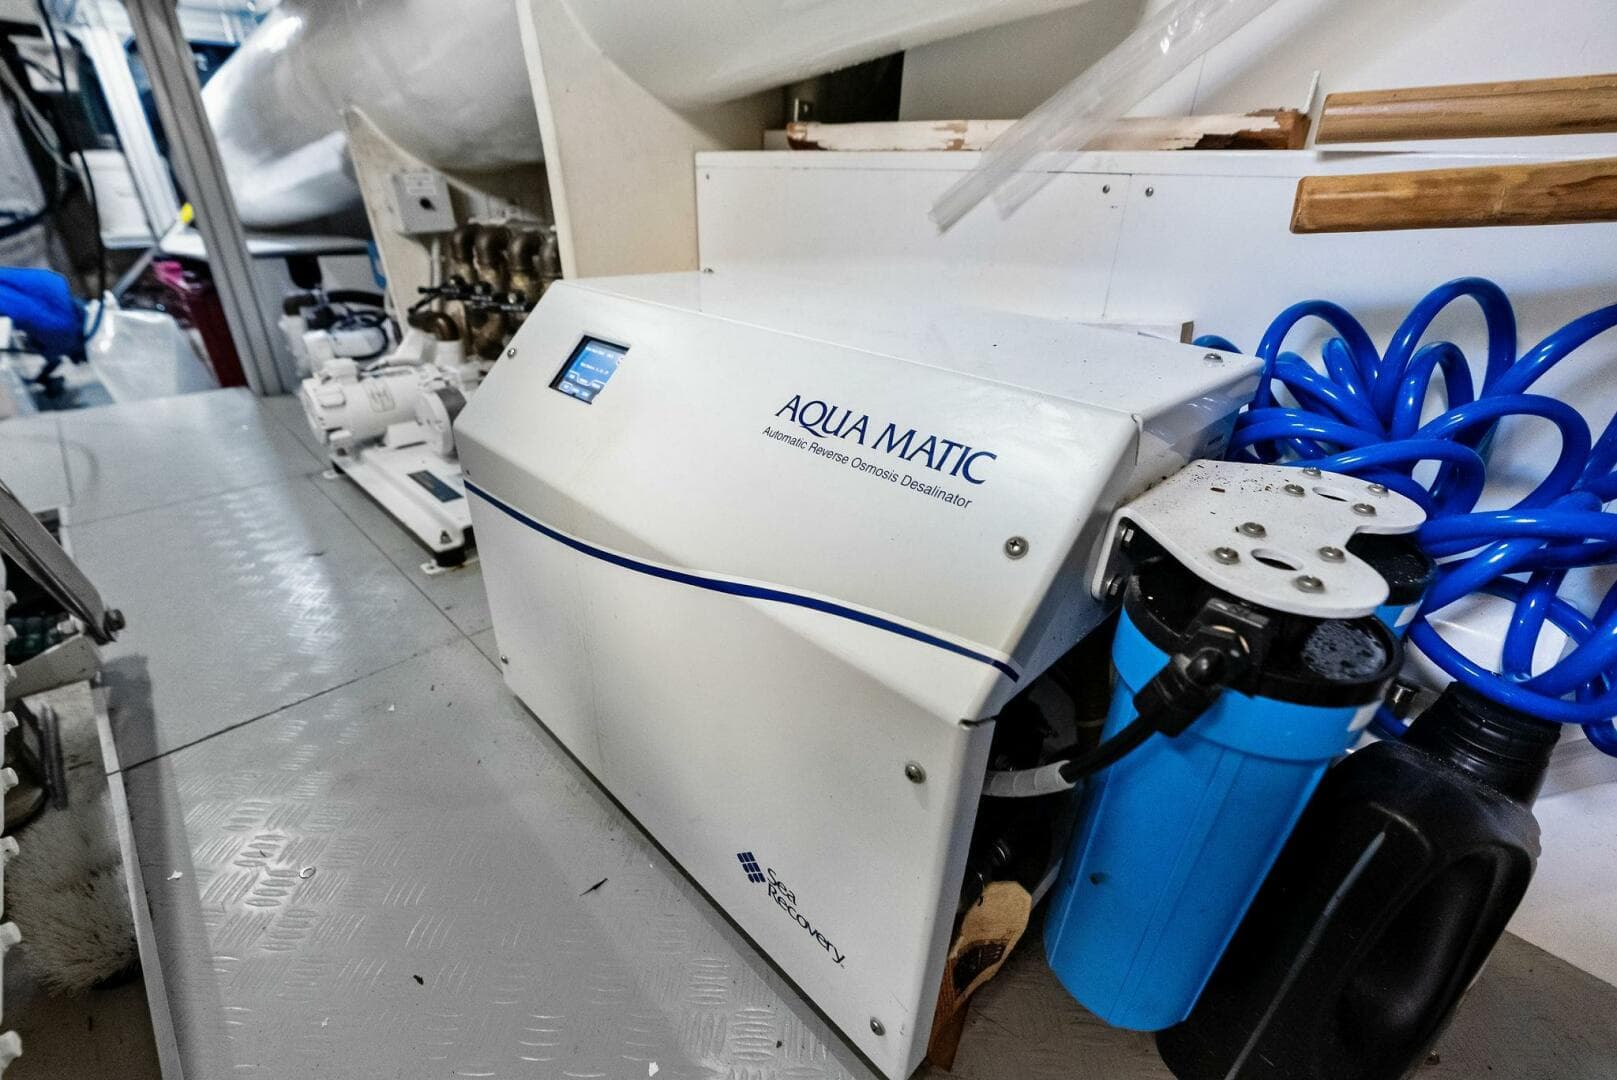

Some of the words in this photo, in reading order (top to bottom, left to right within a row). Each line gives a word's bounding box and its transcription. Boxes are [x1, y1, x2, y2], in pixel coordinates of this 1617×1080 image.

[762, 426, 808, 450] Automatic
[808, 441, 850, 464] Reverse
[851, 457, 899, 483] Osmosis
[900, 475, 973, 509] Desalinator
[775, 394, 870, 446] AQUA
[871, 422, 998, 485] MATIC
[767, 868, 797, 906] Sea
[768, 883, 845, 964] Recovery
